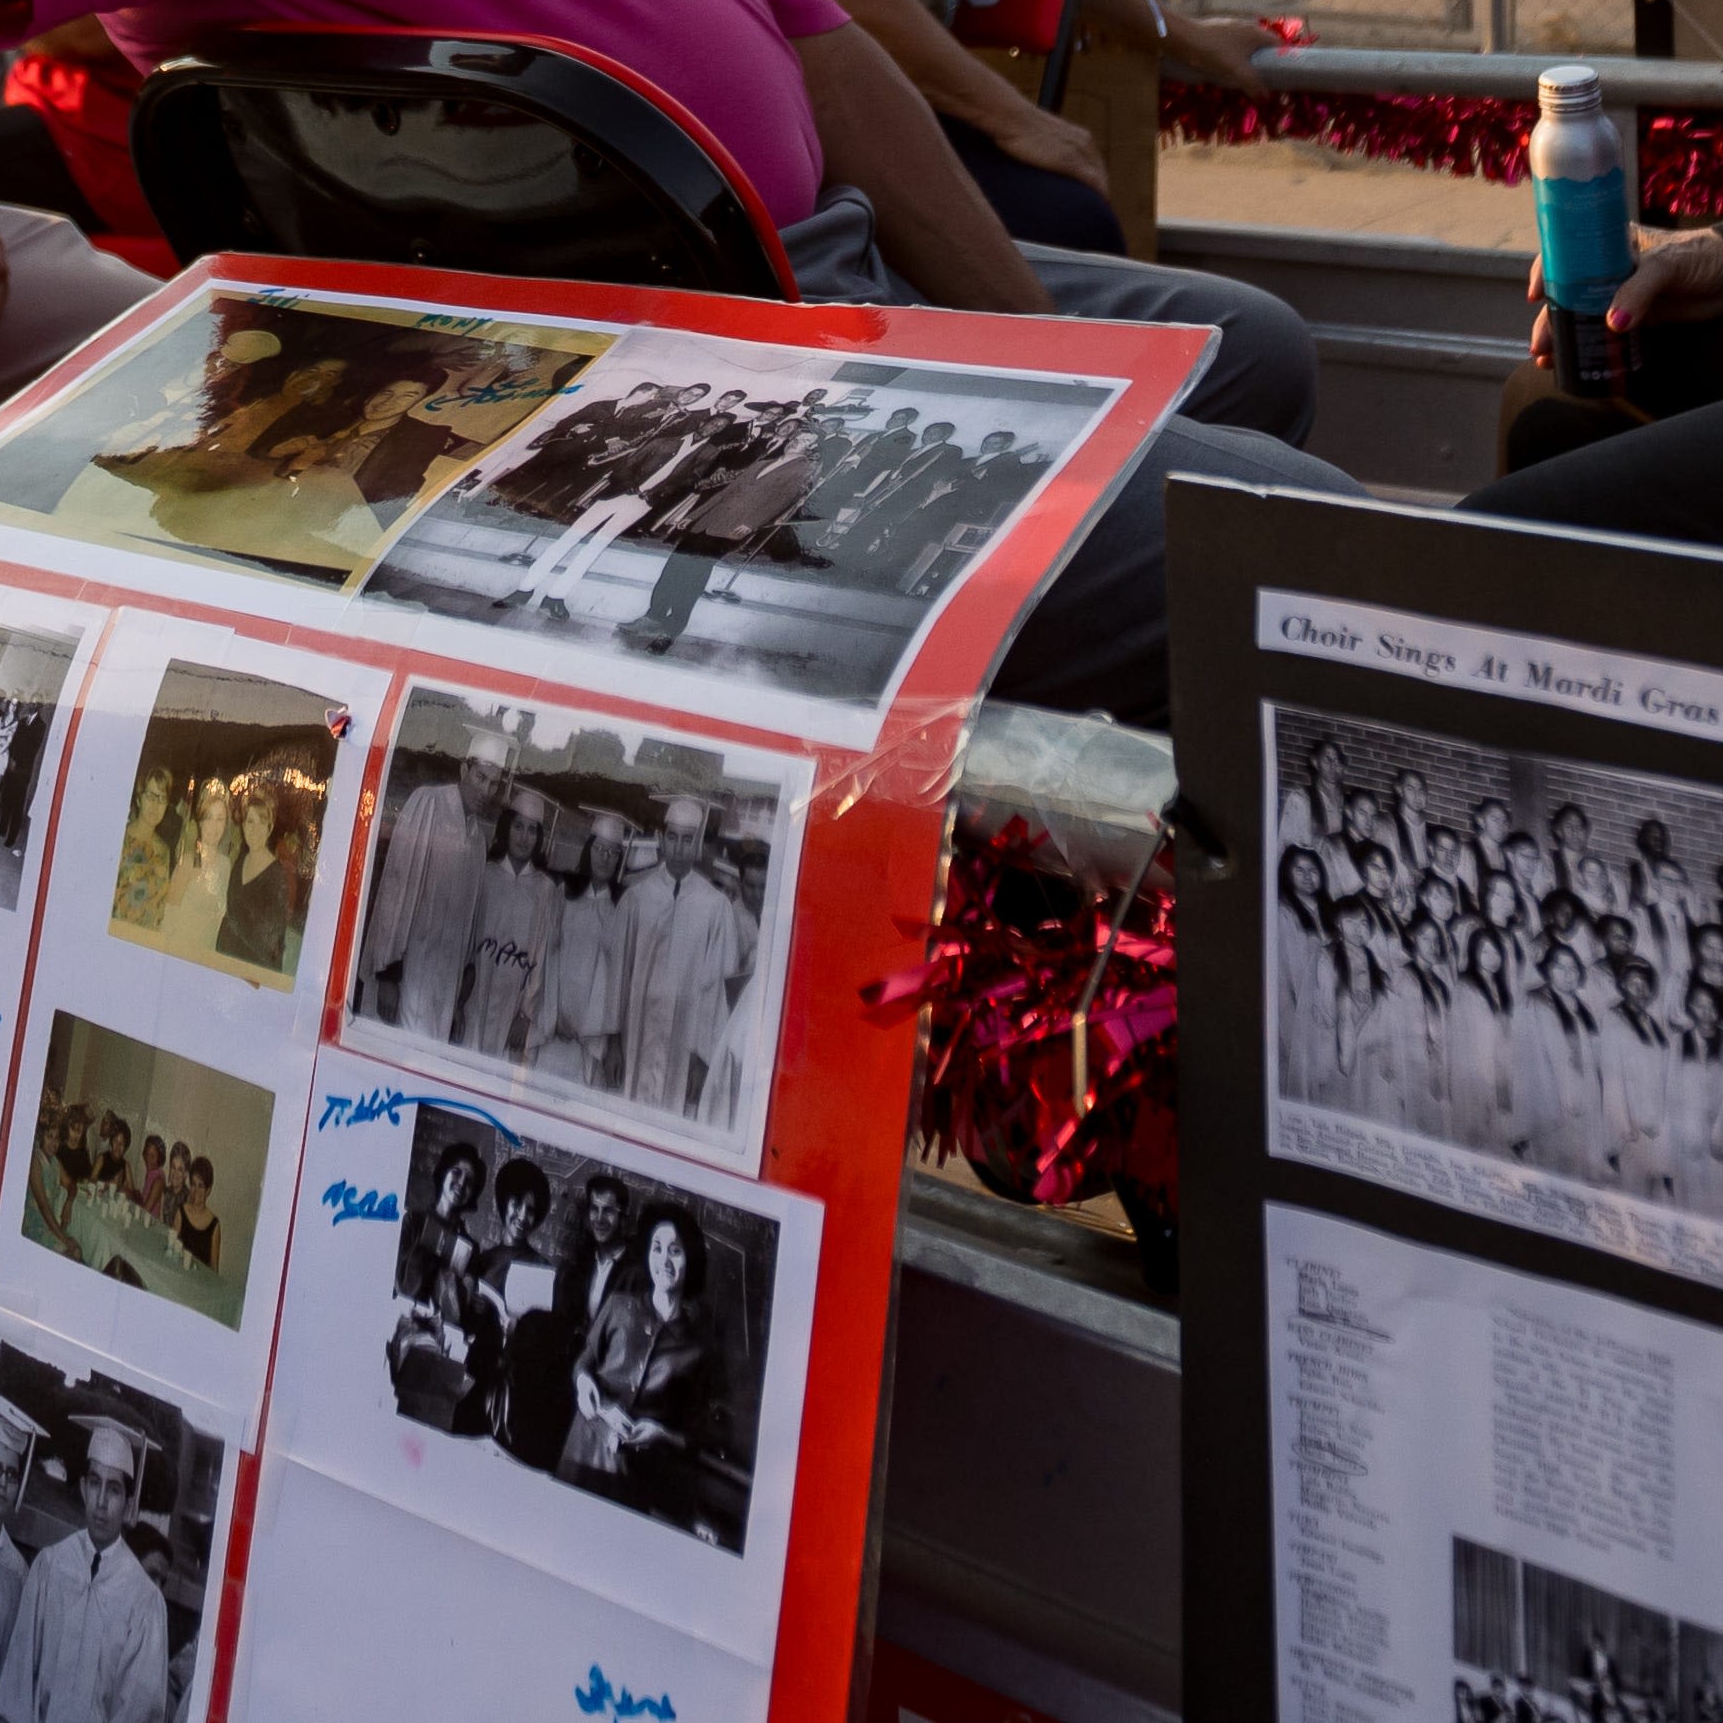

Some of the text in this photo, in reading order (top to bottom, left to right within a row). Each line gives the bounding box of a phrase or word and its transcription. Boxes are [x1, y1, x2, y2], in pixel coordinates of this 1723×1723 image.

[1280, 614, 1364, 649] Choir
[1376, 634, 1457, 678] Sings
[1471, 654, 1510, 683] At
[1524, 661, 1624, 707] Mardi
[1638, 686, 1721, 727] Gras
